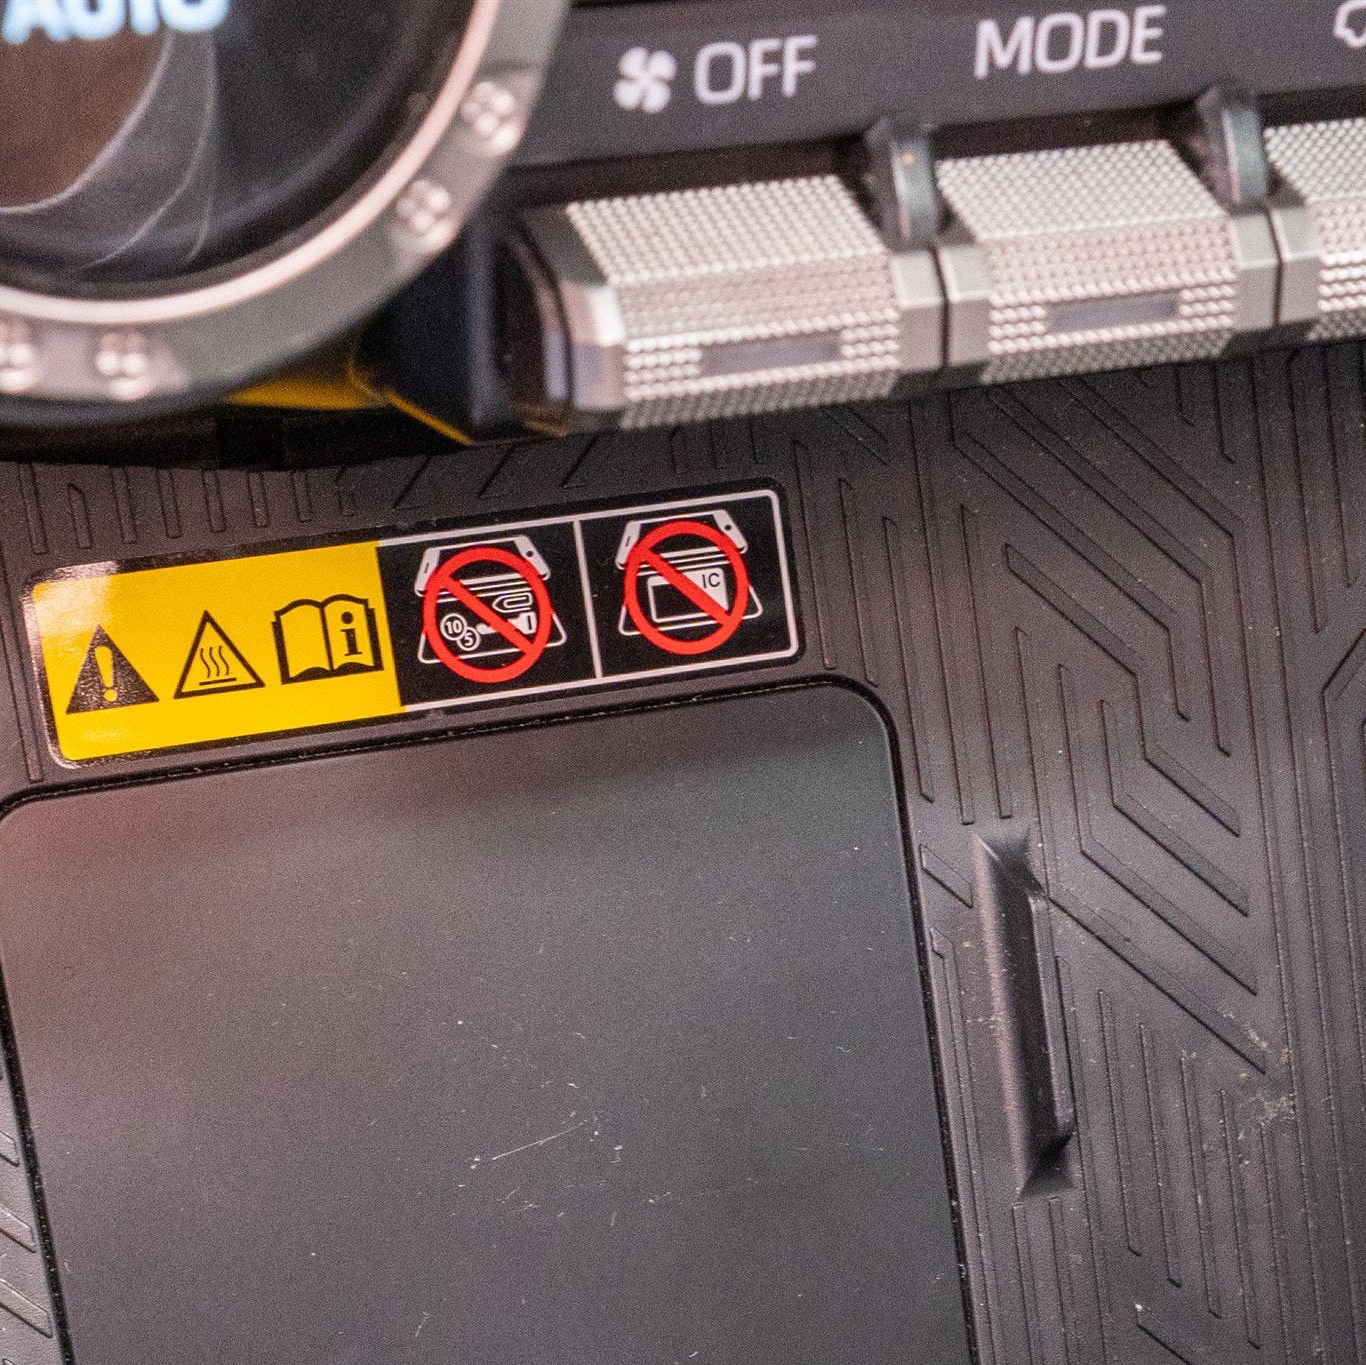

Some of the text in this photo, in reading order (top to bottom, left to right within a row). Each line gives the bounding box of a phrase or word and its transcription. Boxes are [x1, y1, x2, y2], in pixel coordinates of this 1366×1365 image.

[974, 5, 1168, 78] MODE
[693, 35, 818, 104] OFF
[702, 572, 721, 589] IC
[446, 620, 462, 634] 10
